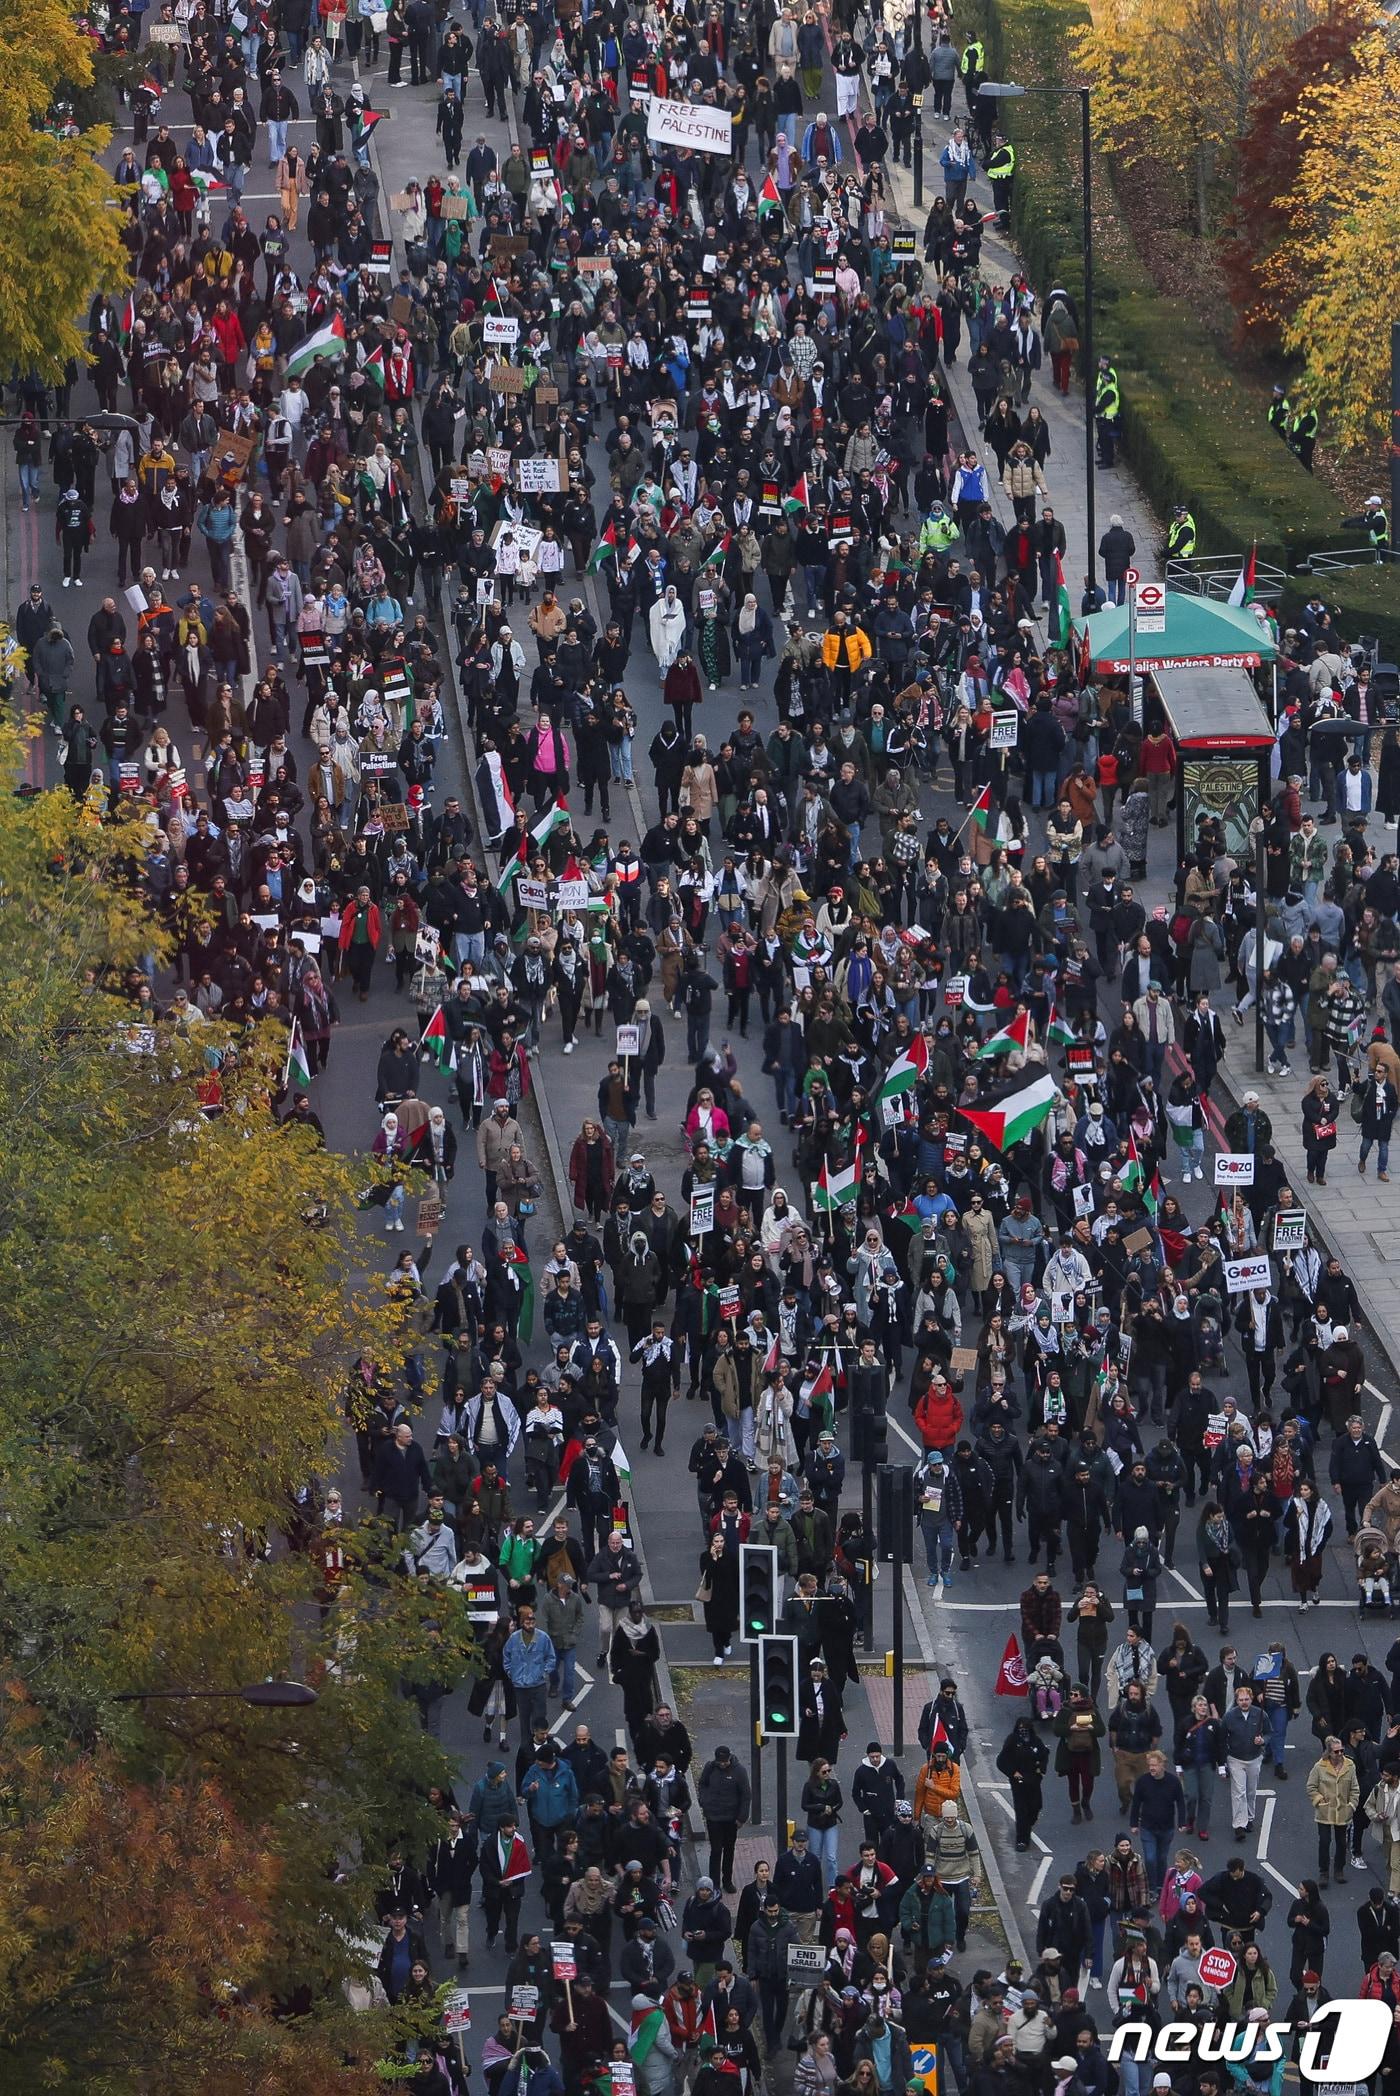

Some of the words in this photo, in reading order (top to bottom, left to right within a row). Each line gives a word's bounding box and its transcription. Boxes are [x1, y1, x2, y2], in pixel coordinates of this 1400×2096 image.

[658, 104, 699, 117] FREE
[661, 118, 730, 143] PALESTINE
[491, 452, 509, 461] STOP
[1126, 571, 1137, 583] D
[1113, 660, 1159, 673] Soalist
[1162, 657, 1209, 670] Workers
[1213, 655, 1244, 669] Party
[992, 726, 1016, 737] FREE
[370, 753, 388, 762] Free
[361, 761, 397, 770] Palestine
[1200, 783, 1242, 792] PALESTINE
[421, 1203, 440, 1213] EXIST
[692, 1207, 713, 1220] FREE
[1275, 1226, 1303, 1237] FREE
[476, 1591, 495, 1601] ISRAEL
[796, 1949, 817, 1960] END
[791, 1957, 821, 1967] ISRAELI
[1207, 1955, 1231, 1970] STOP
[1203, 1966, 1229, 1979] GENOCIDE
[934, 1990, 950, 1999] ILA
